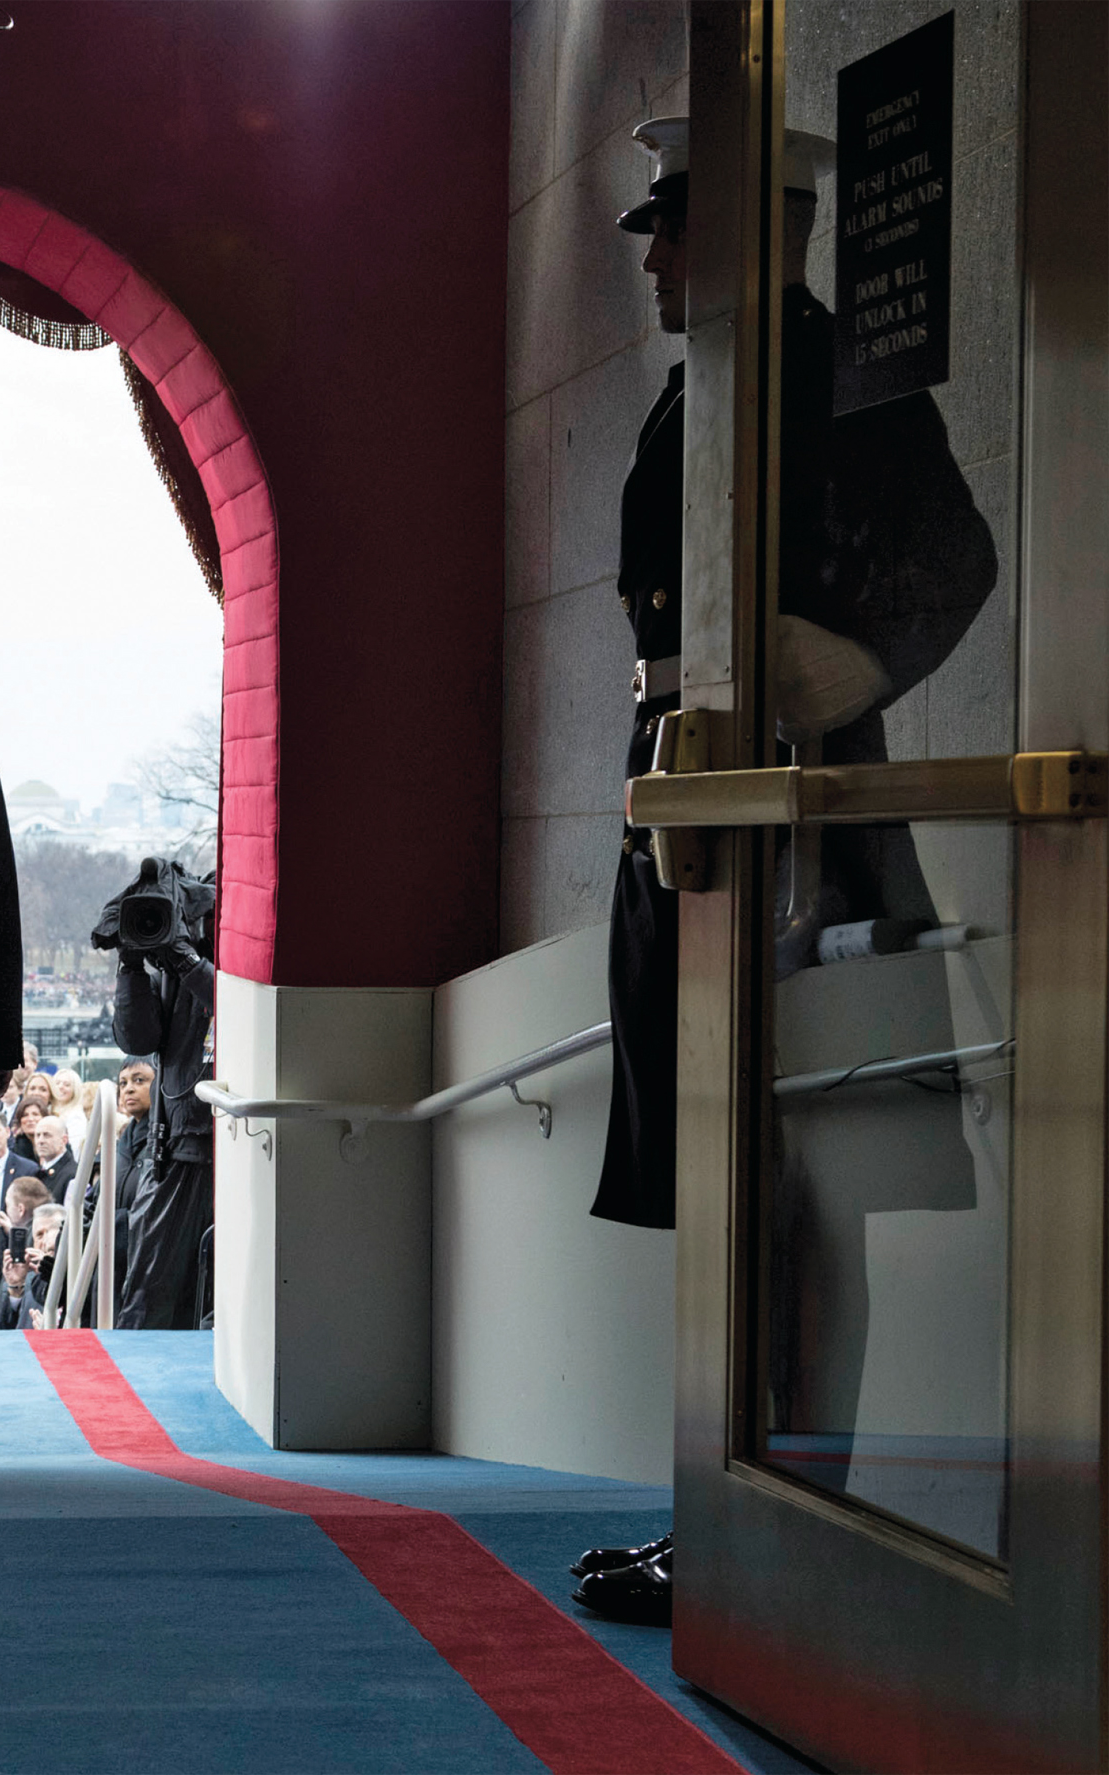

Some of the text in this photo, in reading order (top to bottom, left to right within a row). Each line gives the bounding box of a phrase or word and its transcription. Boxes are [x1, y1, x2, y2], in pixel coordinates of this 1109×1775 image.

[866, 90, 920, 129] EMERGENCY
[868, 115, 917, 150] EXIT ONLY
[854, 150, 932, 203] PUSH UNTIL
[844, 177, 943, 238] ALARM SOUNDS
[855, 259, 928, 304] DOOR WILL
[855, 290, 927, 334] UNLOCK IN
[855, 322, 928, 366] 15 SECONDS
